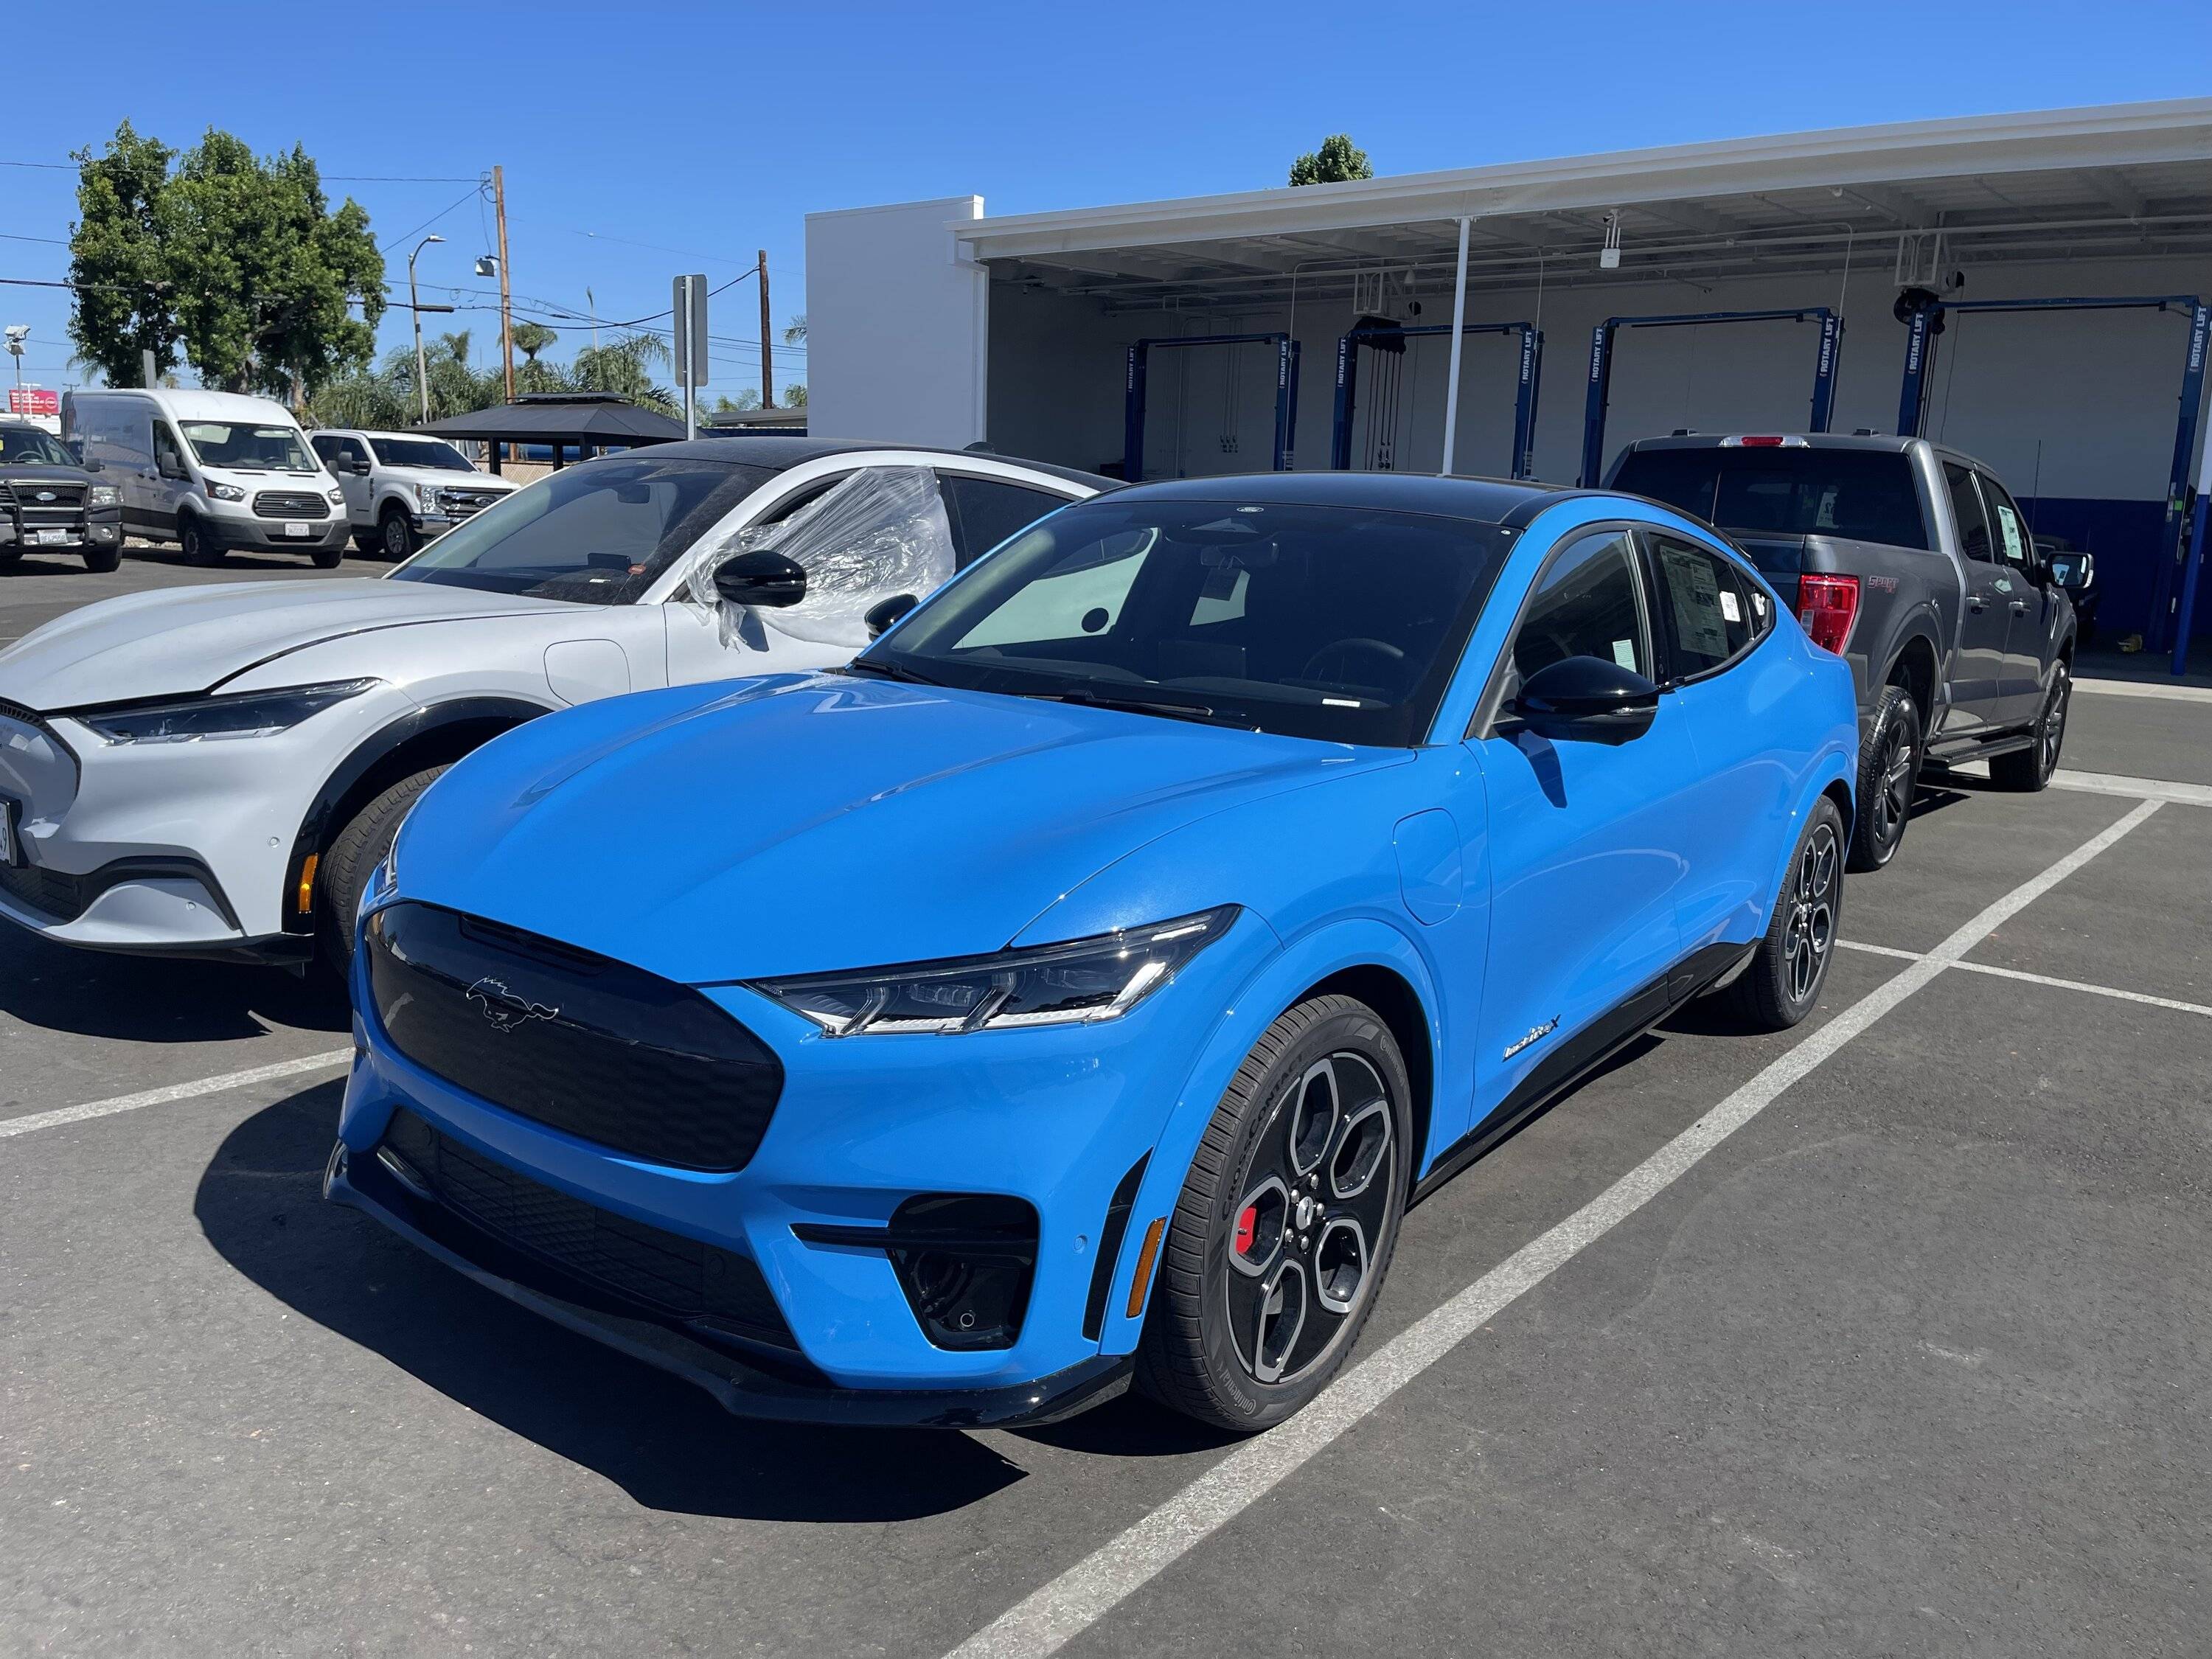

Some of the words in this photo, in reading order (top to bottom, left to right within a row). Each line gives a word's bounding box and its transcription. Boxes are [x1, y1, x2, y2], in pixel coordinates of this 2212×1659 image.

[1825, 318, 1834, 335] LIFT
[1914, 313, 1923, 332] LIFT
[2190, 330, 2204, 367] ROTARY
[2197, 306, 2207, 327] LIFT
[1522, 349, 1530, 380] ROTARY
[1593, 347, 1601, 378] ROTARY
[1820, 338, 1832, 373] ROTARY
[1909, 334, 1921, 370] ROTARY
[1338, 355, 1346, 384] ROTARY
[1868, 576, 1899, 588] SPORT
[1380, 1034, 1406, 1088] Continental
[1219, 1368, 1256, 1415] Continental
